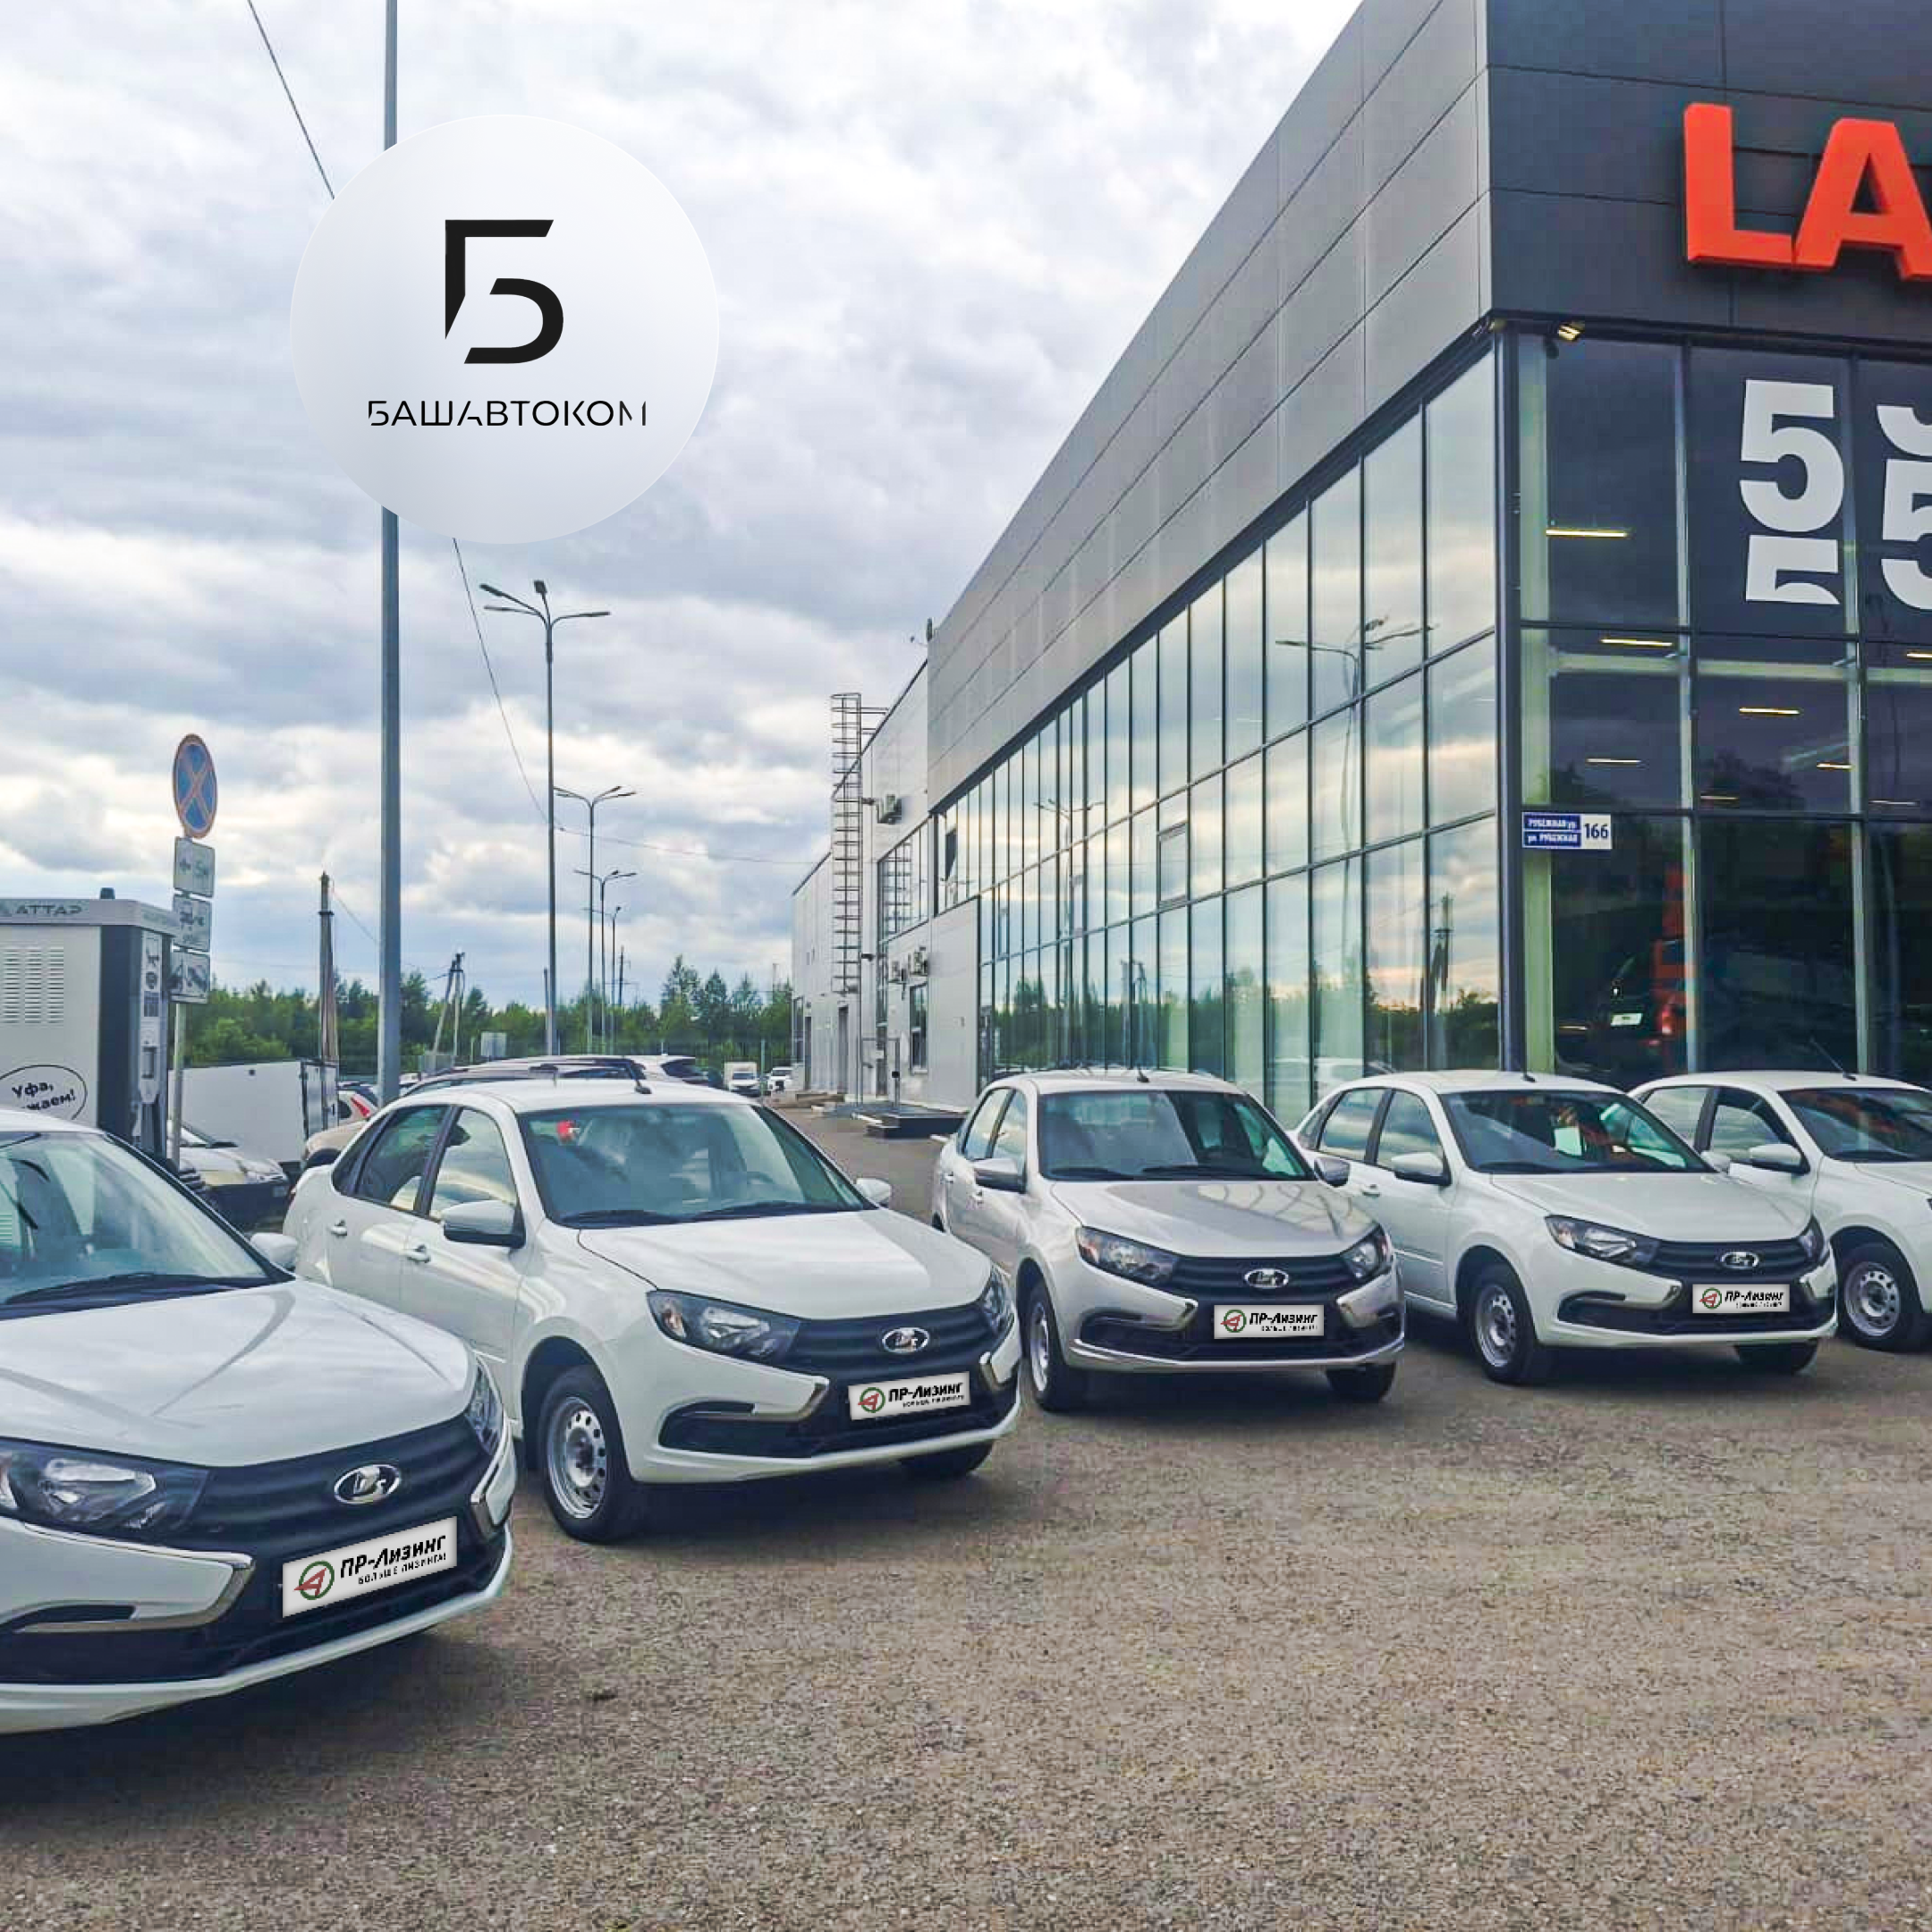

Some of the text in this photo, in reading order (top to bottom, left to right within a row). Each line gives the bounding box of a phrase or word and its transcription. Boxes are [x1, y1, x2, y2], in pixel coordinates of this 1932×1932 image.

[1683, 102, 1932, 282] LA
[1739, 378, 1844, 532] 5
[1584, 823, 1608, 839] 166
[12, 1081, 54, 1098] Уфа,
[1249, 1312, 1318, 1326] ПР-Лизинг
[888, 1382, 964, 1402] ПР-Лизинг
[340, 1535, 446, 1579] ПР-Лизинг
